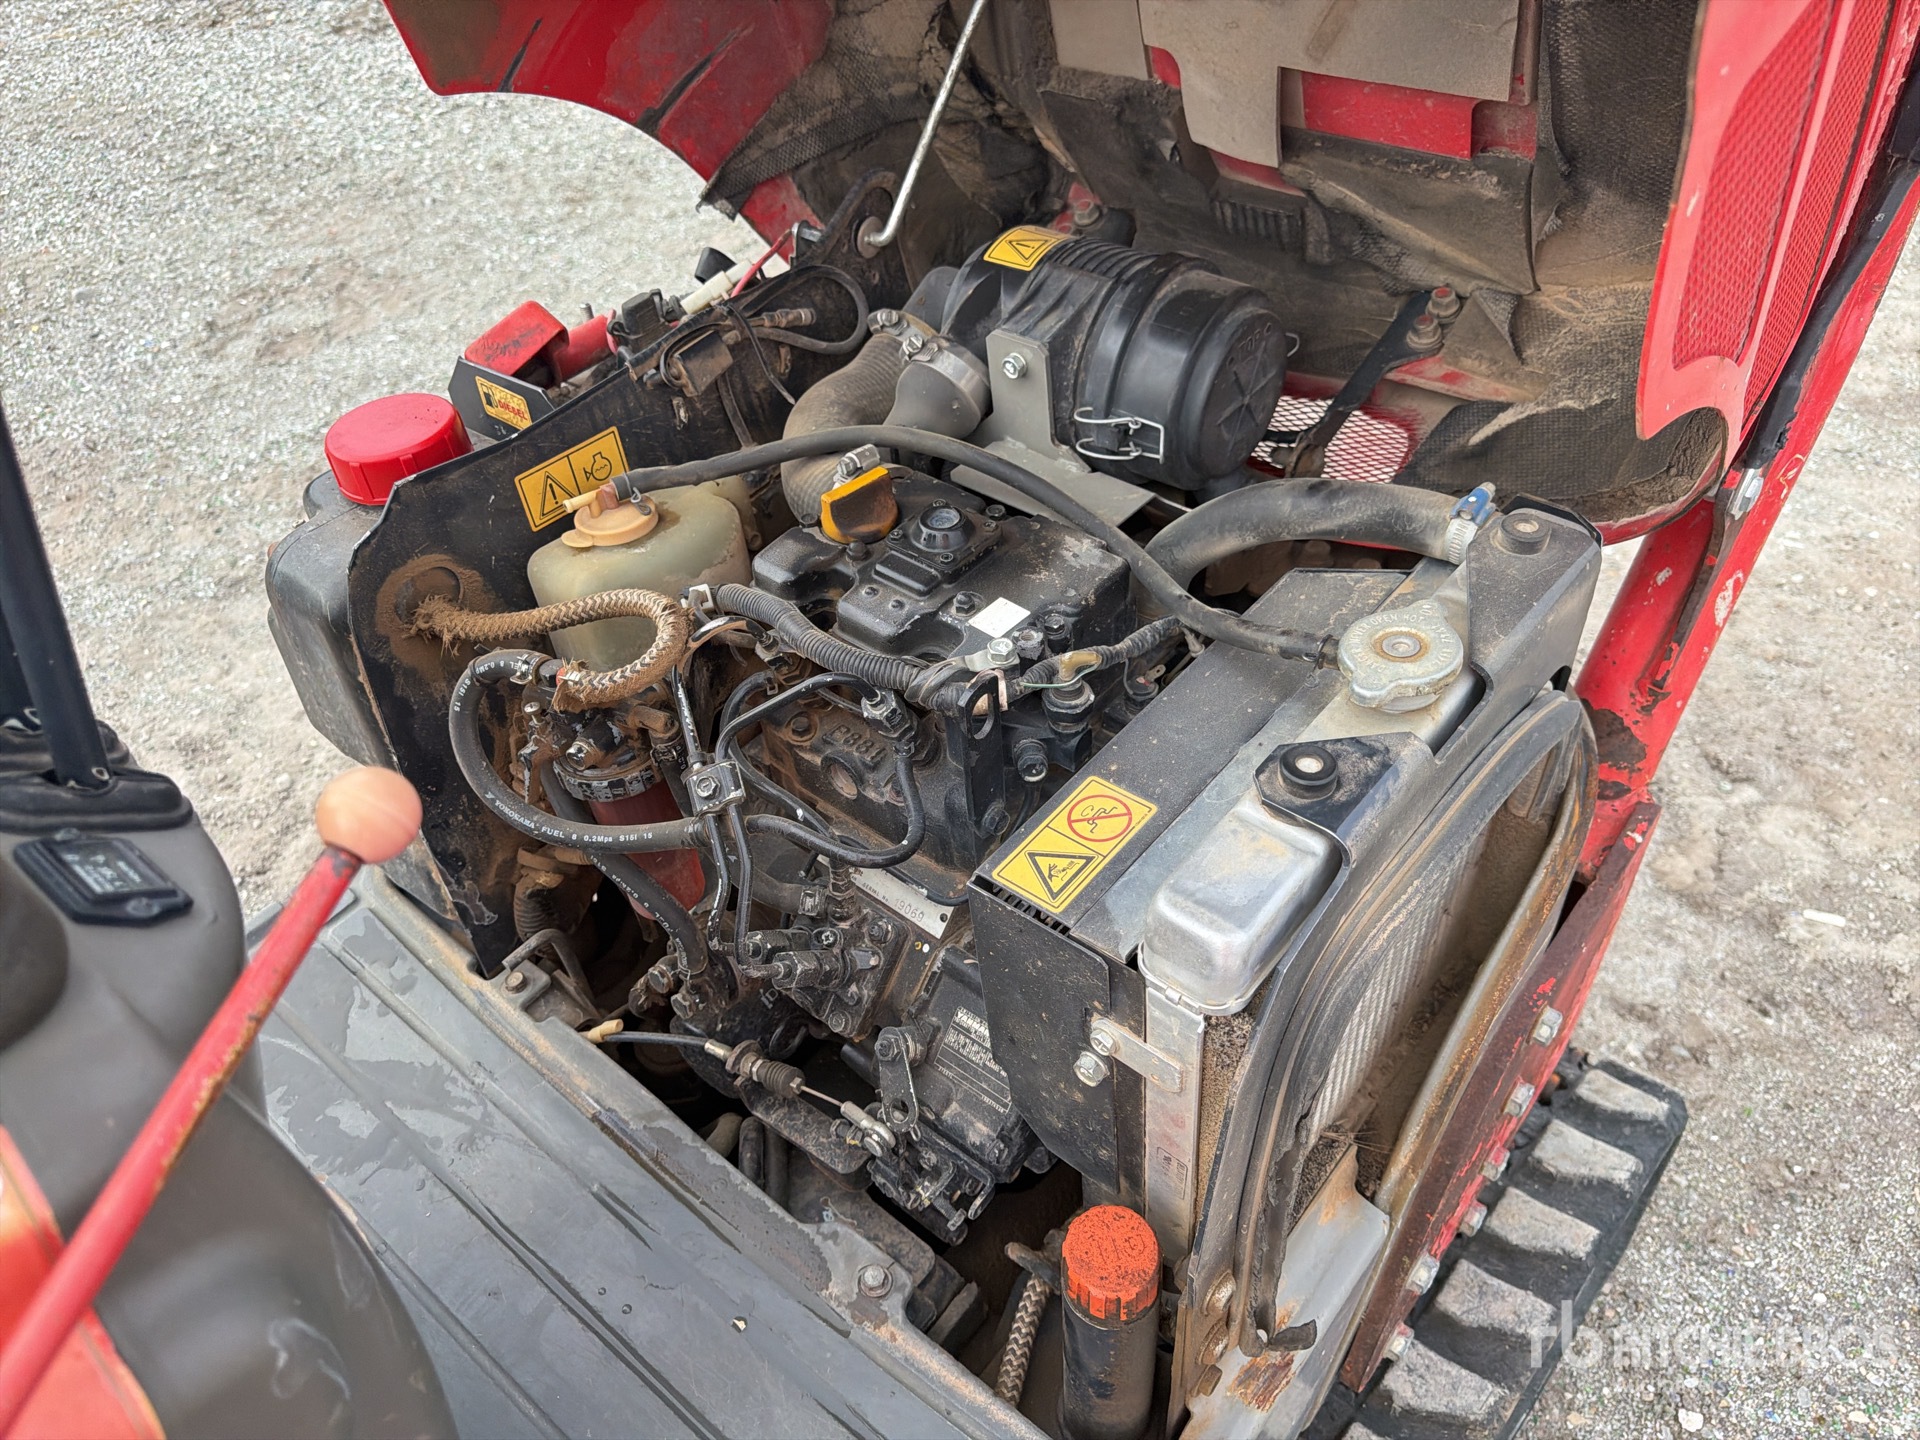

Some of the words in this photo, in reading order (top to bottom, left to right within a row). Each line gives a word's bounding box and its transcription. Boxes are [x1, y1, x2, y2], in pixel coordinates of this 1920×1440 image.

[497, 399, 528, 421] DIESEL
[1370, 613, 1398, 625] OPEN
[1403, 613, 1424, 623] HOT
[475, 661, 495, 675] 0.2Mp
[493, 798, 535, 829] YOKOHAMA
[541, 825, 565, 839] FUEL
[571, 832, 578, 841] 8
[643, 832, 653, 840] 15
[862, 882, 880, 897] SERIAL
[894, 898, 925, 920] 19069
